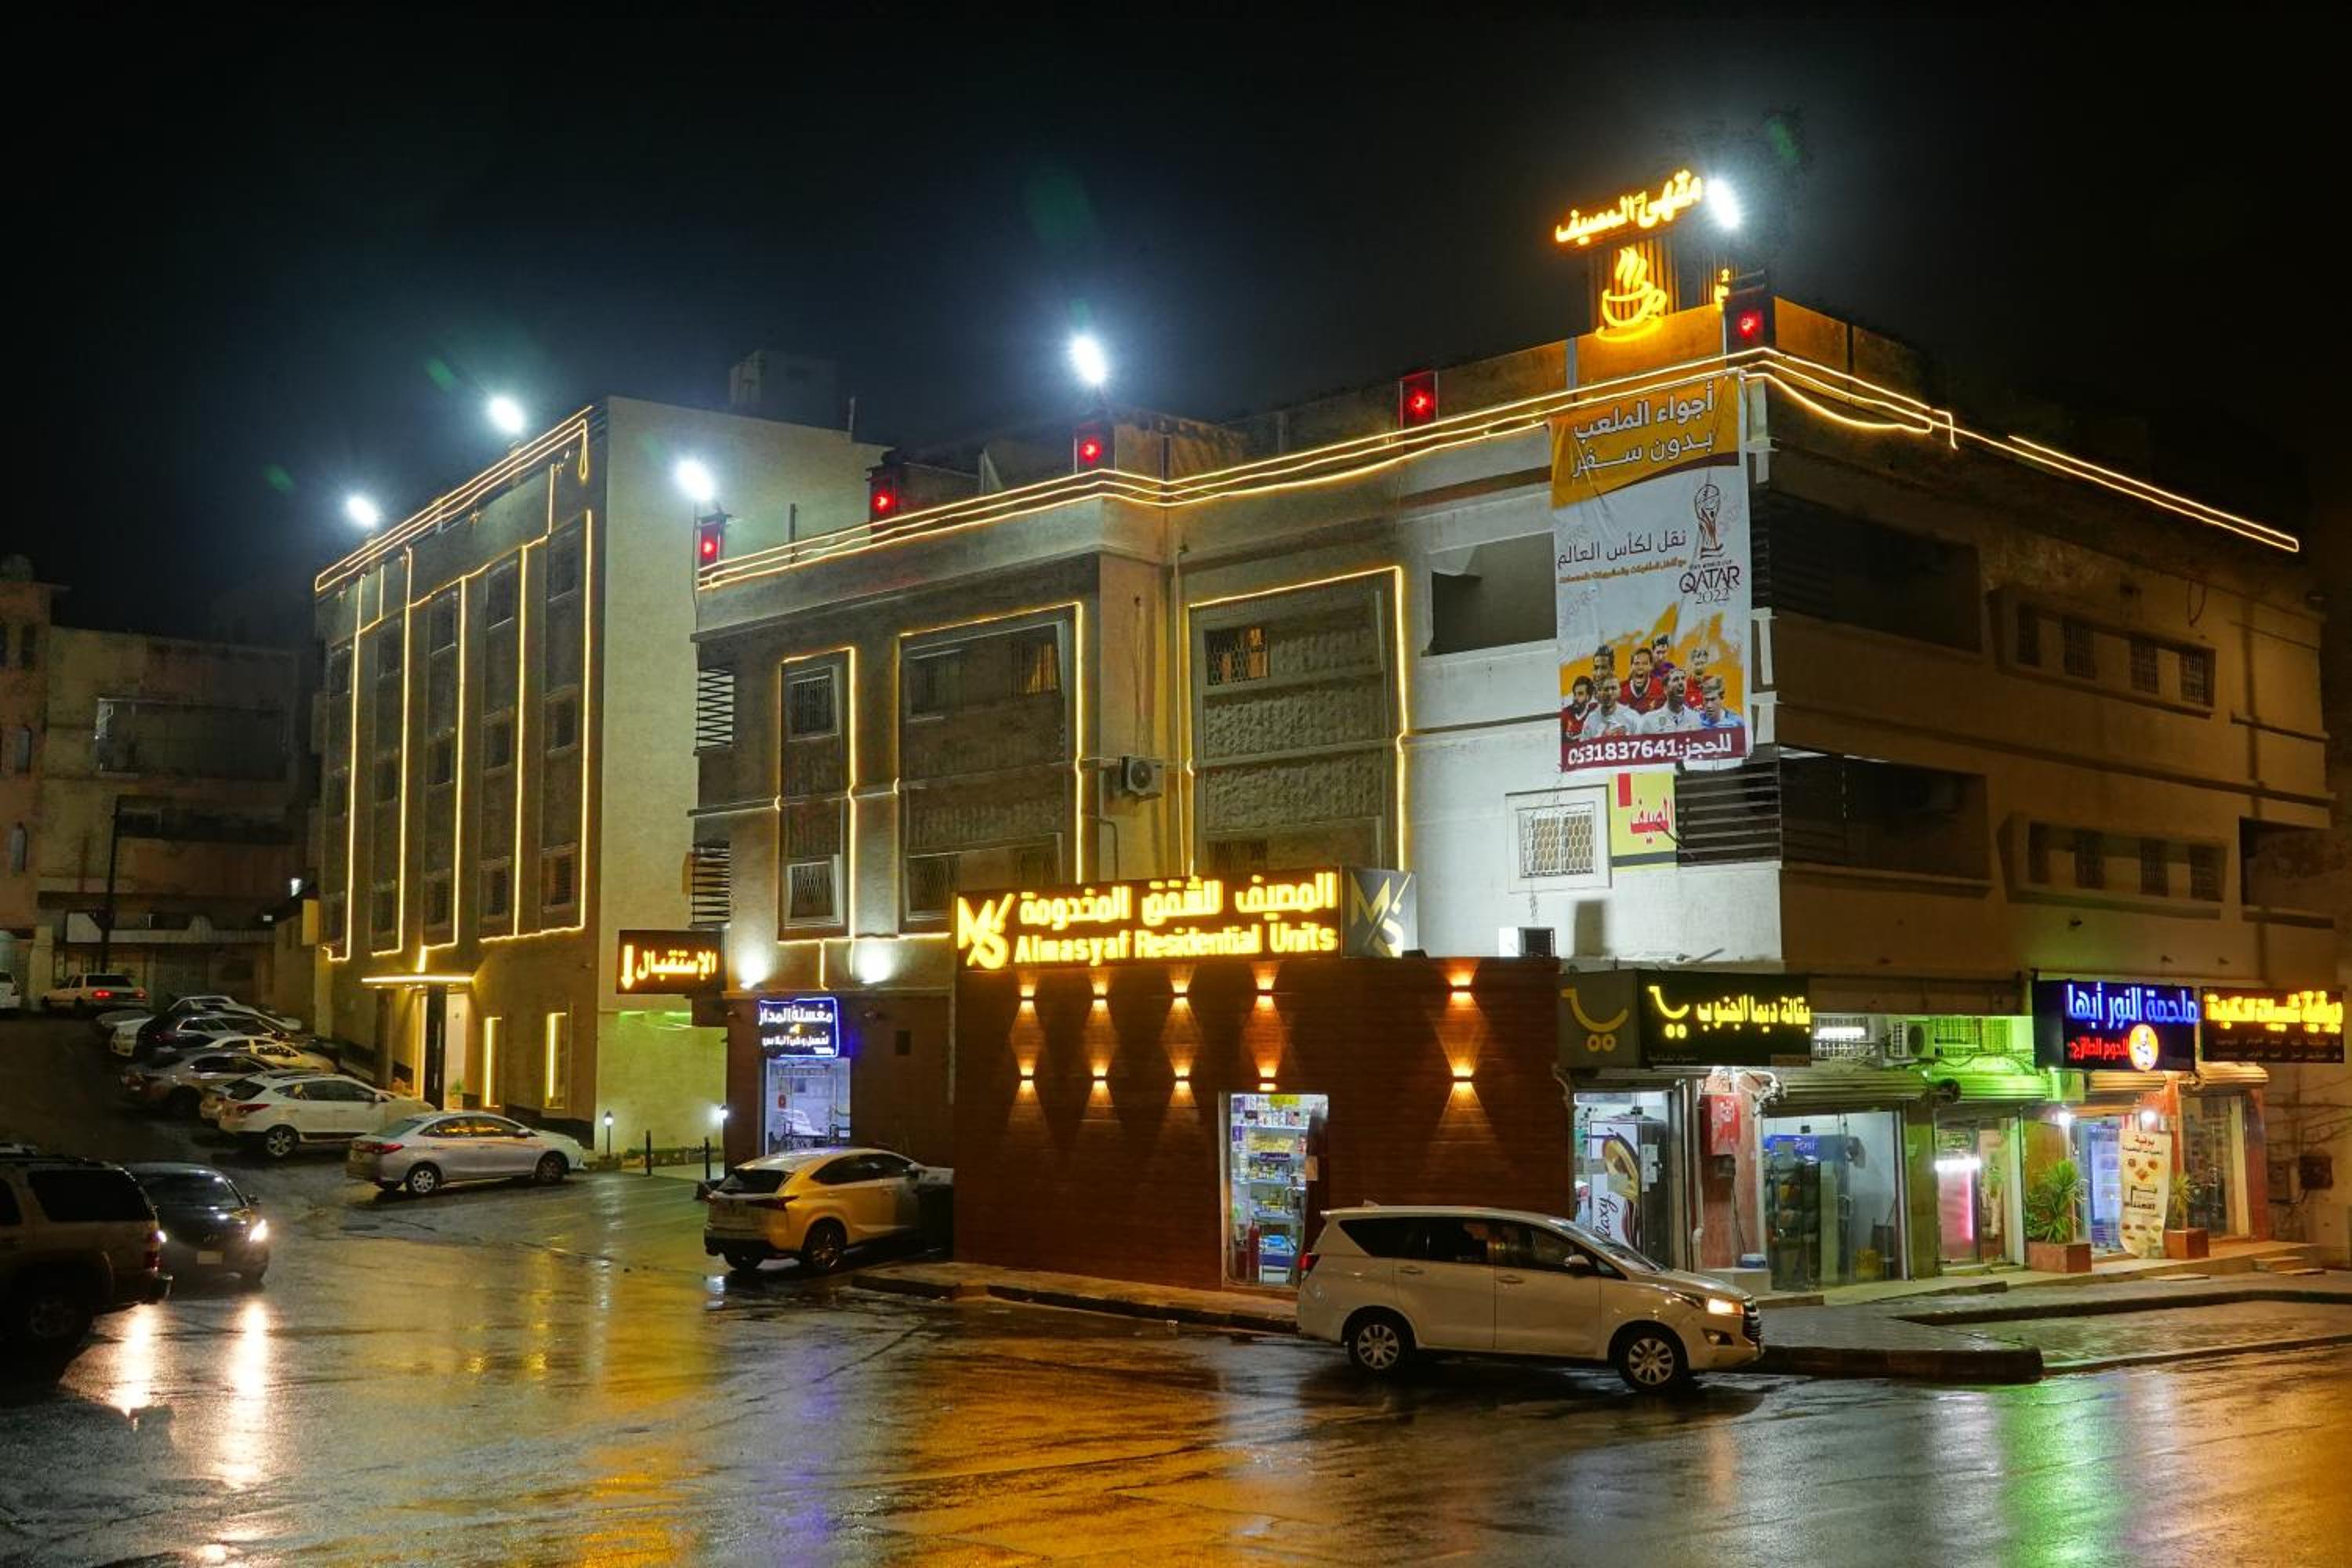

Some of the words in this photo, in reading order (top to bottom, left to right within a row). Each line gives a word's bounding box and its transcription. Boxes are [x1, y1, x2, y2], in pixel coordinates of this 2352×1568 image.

[1555, 195, 1635, 246] المصيف
[1656, 381, 1715, 422] أجواء
[1573, 401, 1650, 442] الملعب
[1650, 430, 1714, 462] بدون
[1557, 541, 1601, 571] العالم
[1606, 531, 1653, 562] لكأس
[1657, 529, 1687, 554] نقل
[1679, 565, 1740, 594] QATAR
[1696, 589, 1731, 604] 2022
[1568, 739, 1677, 766] 0531837641
[1019, 886, 1131, 931] المخدومة
[1235, 870, 1338, 920] المصيف
[1014, 929, 1131, 967] Almasyaf
[1134, 924, 1260, 960] Residential
[1269, 920, 1338, 953] Units
[758, 1006, 791, 1026] المدار
[791, 1003, 834, 1023] مغسلة
[1697, 994, 1749, 1033] الجنوب
[1750, 996, 1779, 1033] ديما
[1780, 996, 1812, 1034] بقالة
[2067, 982, 2103, 1029] أبها
[2107, 986, 2143, 1029] النور
[2146, 988, 2199, 1025] ملحمة
